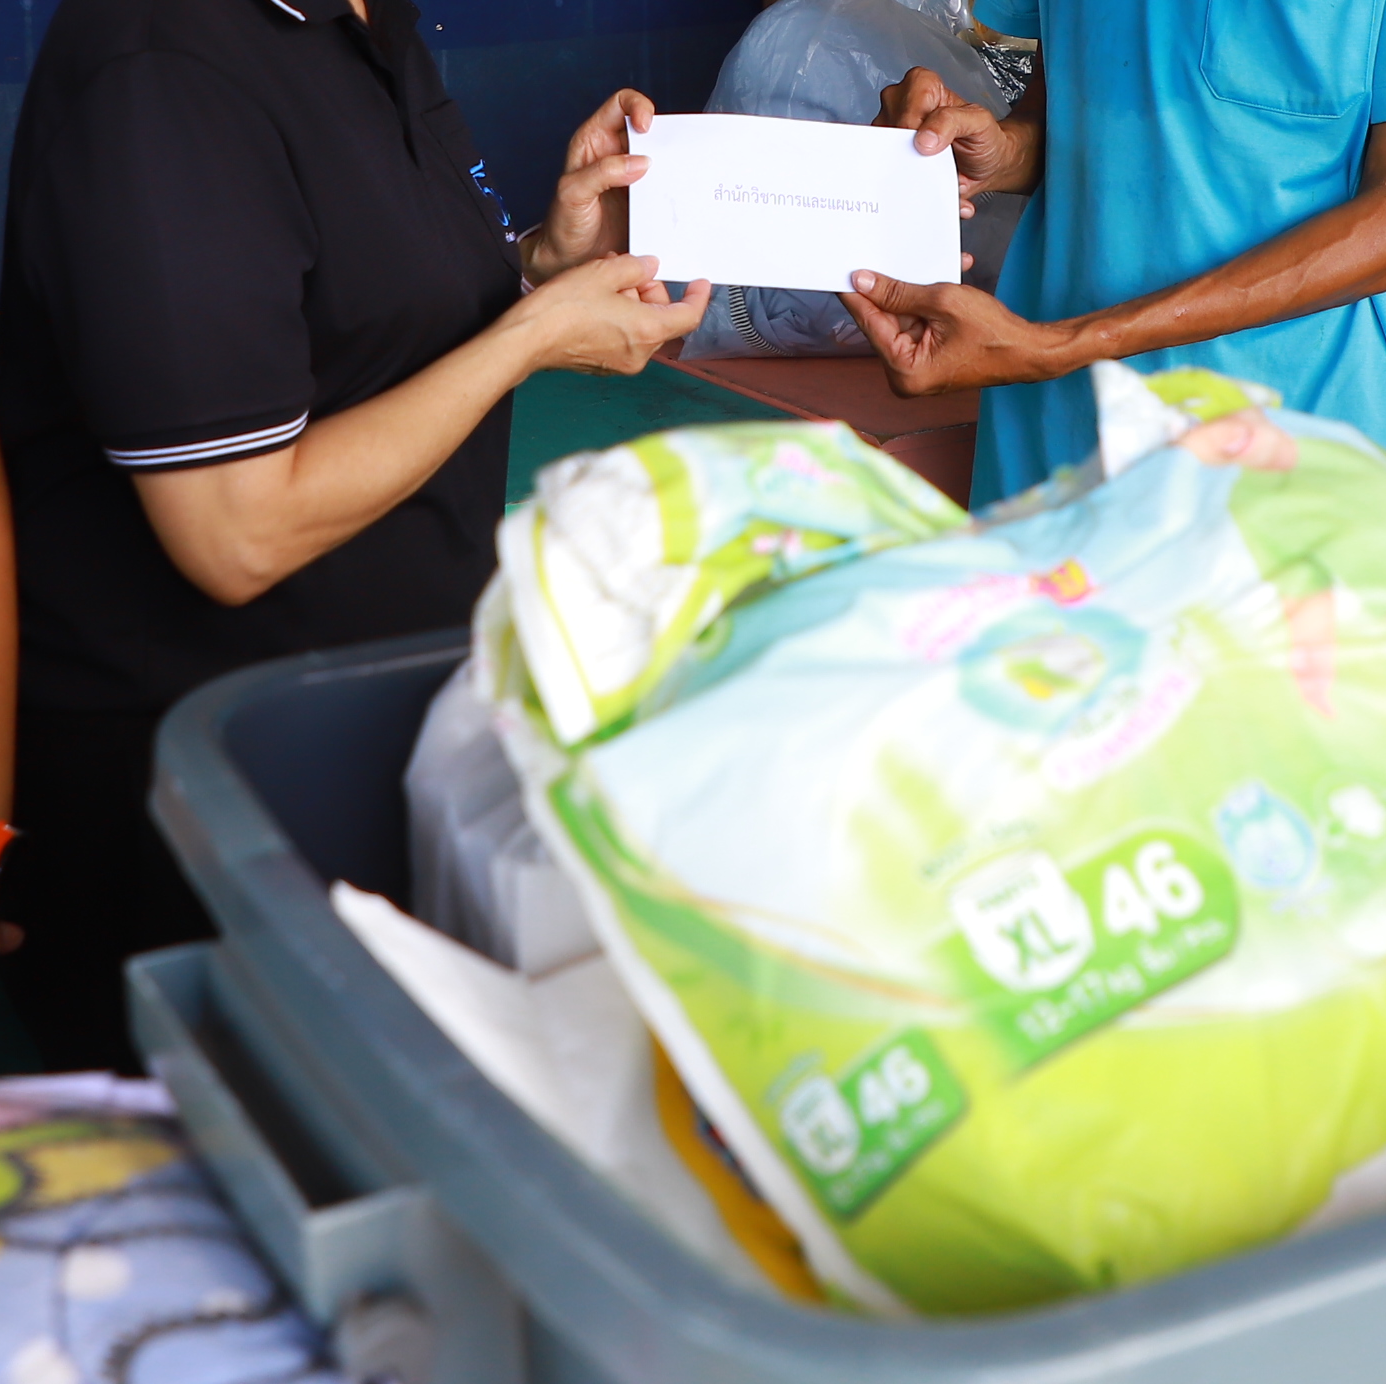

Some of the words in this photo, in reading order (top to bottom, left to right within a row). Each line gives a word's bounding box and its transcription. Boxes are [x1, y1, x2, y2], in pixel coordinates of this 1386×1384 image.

[714, 182, 880, 214] สำนักวิชาการและแผนงาน
[1101, 839, 1206, 939] 46
[857, 1044, 933, 1126] 46
